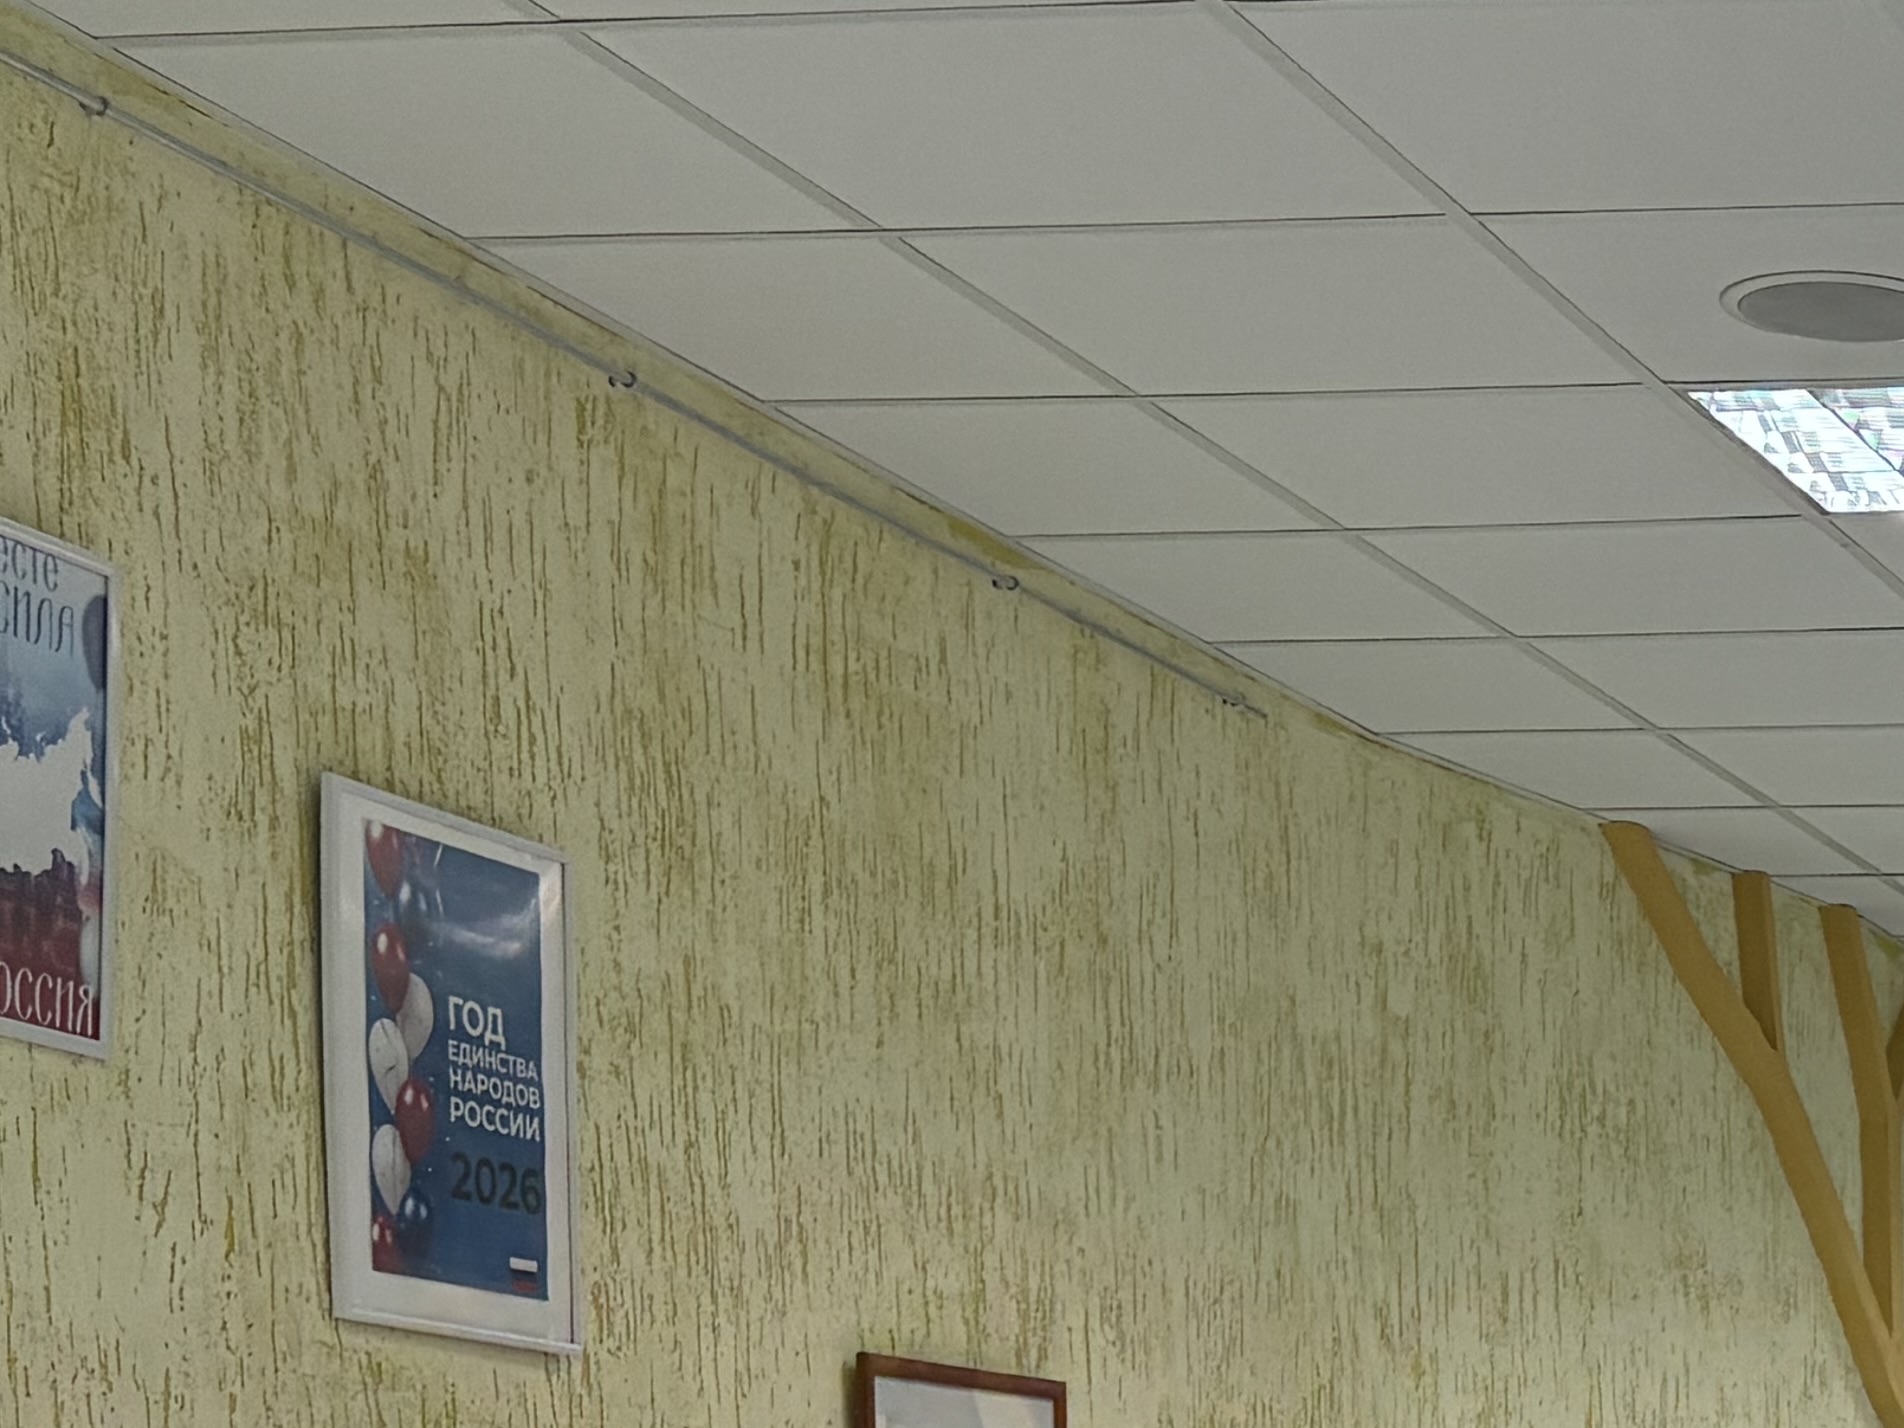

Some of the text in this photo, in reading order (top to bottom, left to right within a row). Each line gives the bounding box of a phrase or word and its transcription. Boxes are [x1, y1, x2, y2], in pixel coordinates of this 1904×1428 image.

[448, 996, 505, 1050] ГОД
[448, 1040, 538, 1081] ЕДИНСТВА
[449, 1067, 541, 1109] НАРОДОВ
[450, 1096, 541, 1142] РОССИИ
[451, 1152, 542, 1216] 2026
